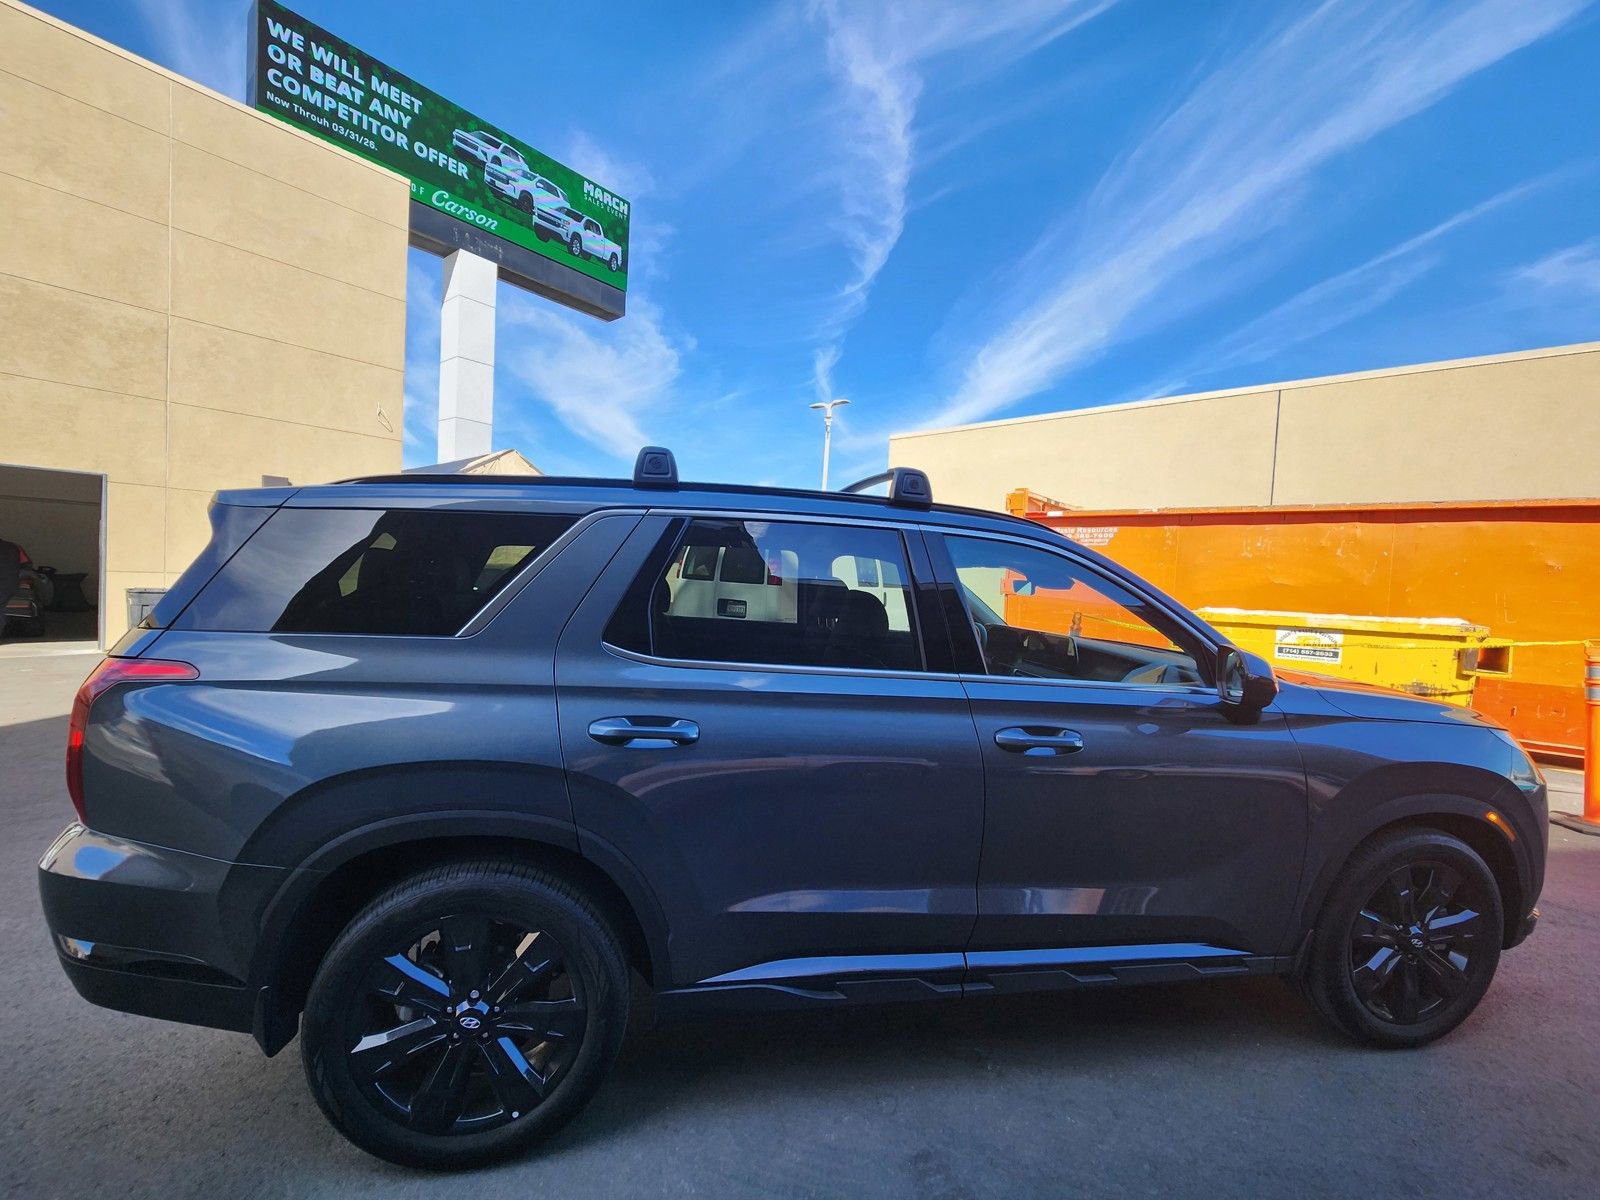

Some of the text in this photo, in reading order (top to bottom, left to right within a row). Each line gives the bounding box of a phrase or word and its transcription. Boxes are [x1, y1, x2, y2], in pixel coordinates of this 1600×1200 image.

[266, 16, 422, 115] WE WILL MEET
[267, 44, 412, 129] OR BEAT ANY
[266, 91, 290, 109] Now
[293, 103, 330, 128] Throuh
[267, 68, 469, 180] COMPETITOR OFFER
[431, 190, 498, 230] Carson
[583, 180, 628, 216] MARCH
[584, 193, 627, 221] SALES EVENT
